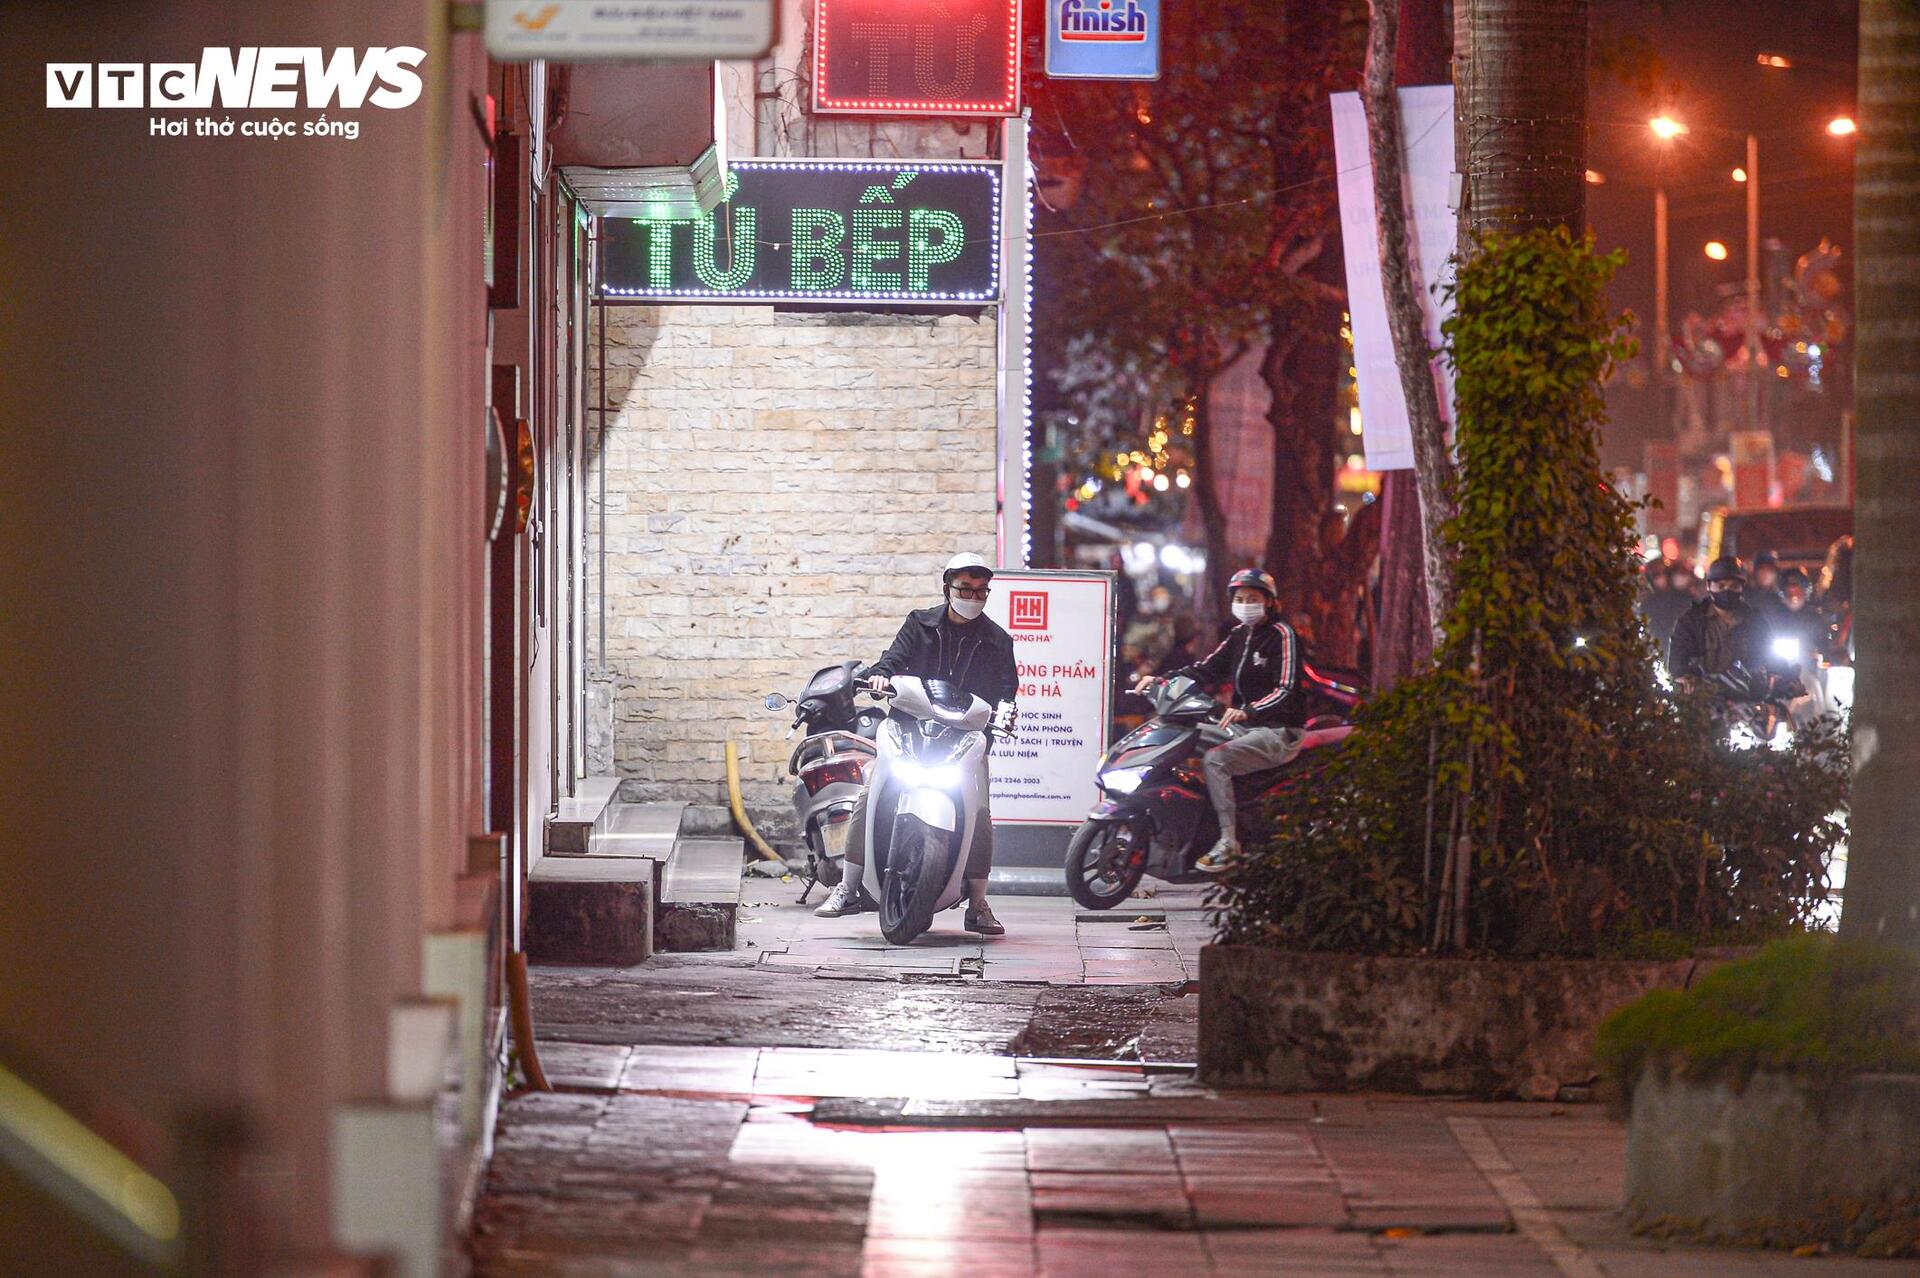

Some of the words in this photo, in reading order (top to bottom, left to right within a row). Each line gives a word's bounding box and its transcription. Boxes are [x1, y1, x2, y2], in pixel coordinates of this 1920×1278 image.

[1060, 0, 1146, 32] finish
[790, 172, 965, 292] BẾP
[1016, 660, 1047, 677] ÒNG
[1053, 659, 1095, 678] PHẨM
[1041, 681, 1061, 696] HÀ
[1042, 712, 1062, 720] SINH
